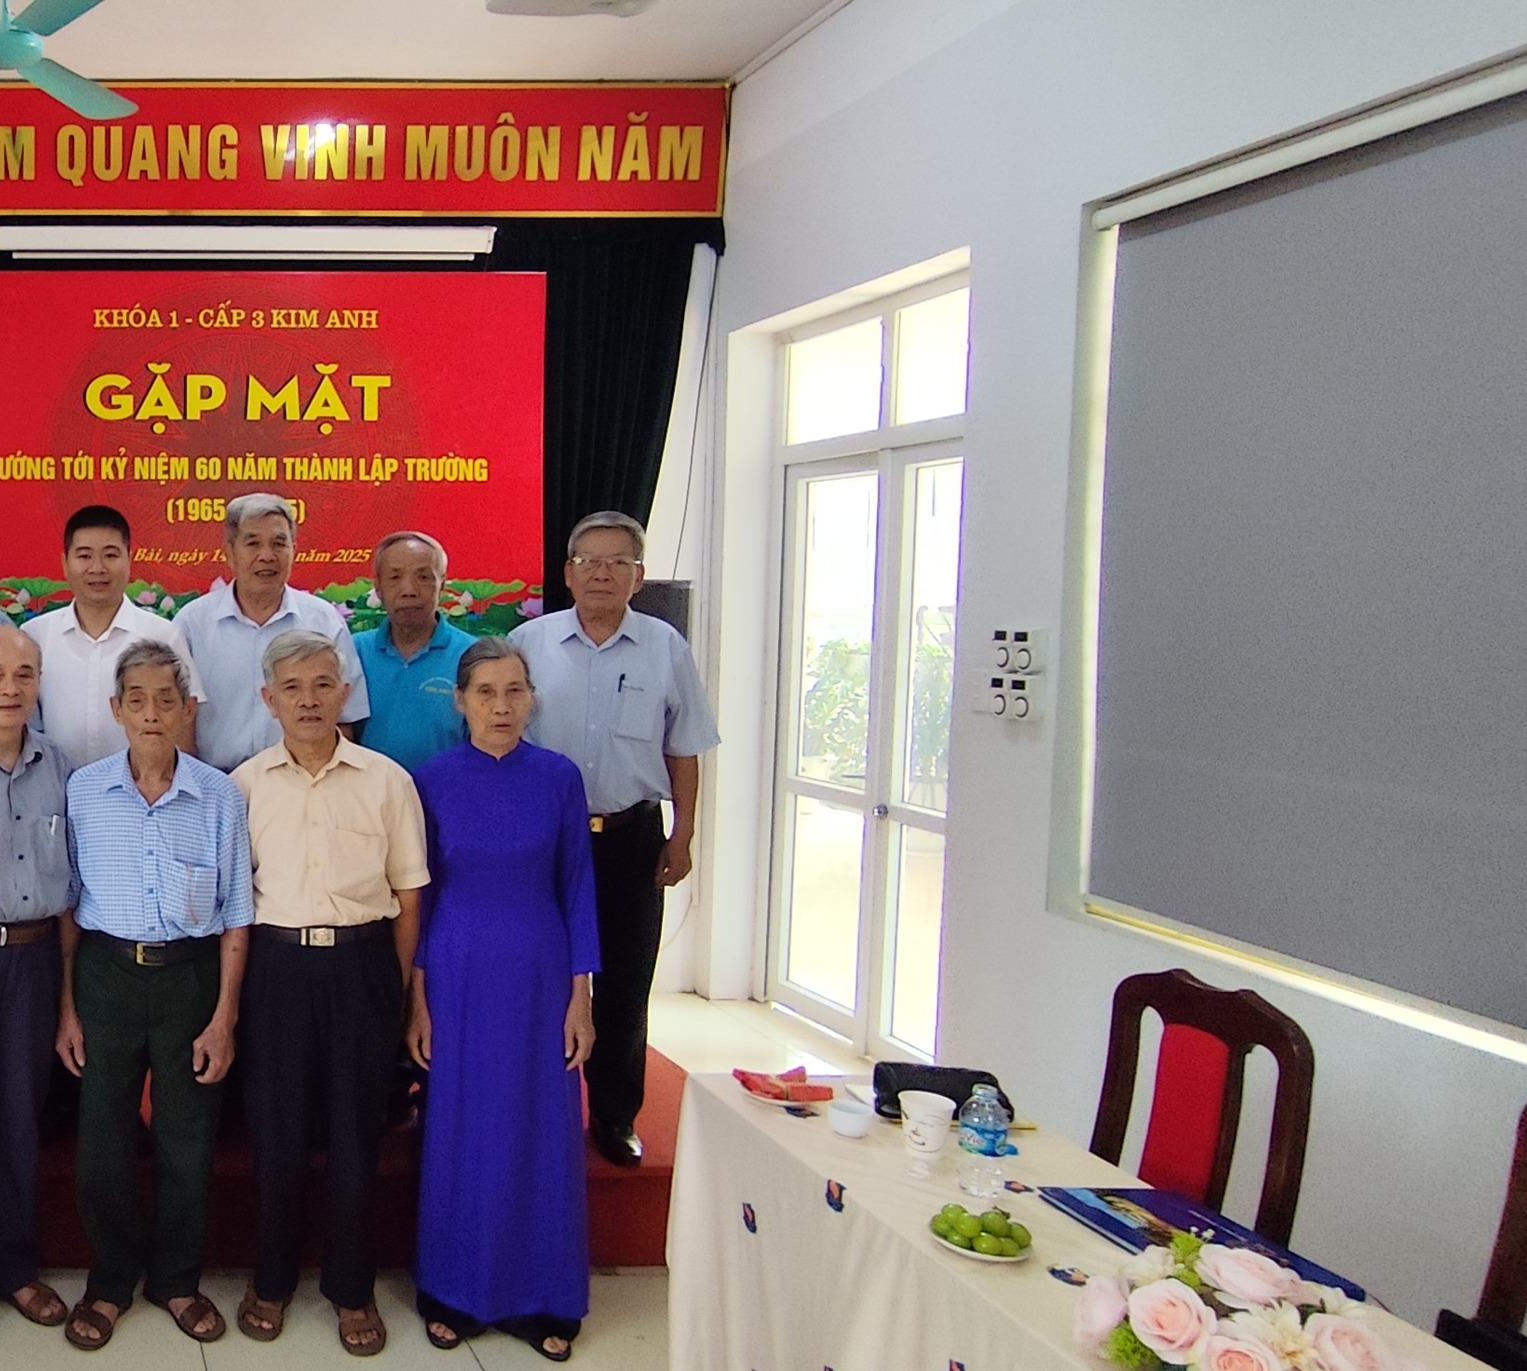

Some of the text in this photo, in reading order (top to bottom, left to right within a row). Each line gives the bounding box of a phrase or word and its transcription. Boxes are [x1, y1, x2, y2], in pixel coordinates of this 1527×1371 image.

[56, 124, 239, 187] QUANG
[260, 124, 387, 181] VINH
[404, 112, 561, 181] MUÔN
[577, 111, 704, 181] NĂM
[93, 303, 163, 328] KHÓA
[169, 310, 179, 328] 1
[198, 300, 245, 328] CẤP
[251, 309, 264, 328] 3
[270, 309, 319, 328] KIM
[325, 309, 379, 328] ANH
[85, 362, 392, 435] GẶP MẶT
[61, 450, 95, 480] TỚI
[100, 447, 128, 480] KỶ
[134, 452, 189, 485] NIỆM
[195, 457, 221, 480] 60
[227, 453, 277, 481] NĂM
[283, 453, 353, 481] THÀNH
[358, 453, 399, 486] LẬP
[404, 452, 488, 482] TRƯỜNG
[295, 549, 331, 562] năm
[333, 549, 373, 563] 2025
